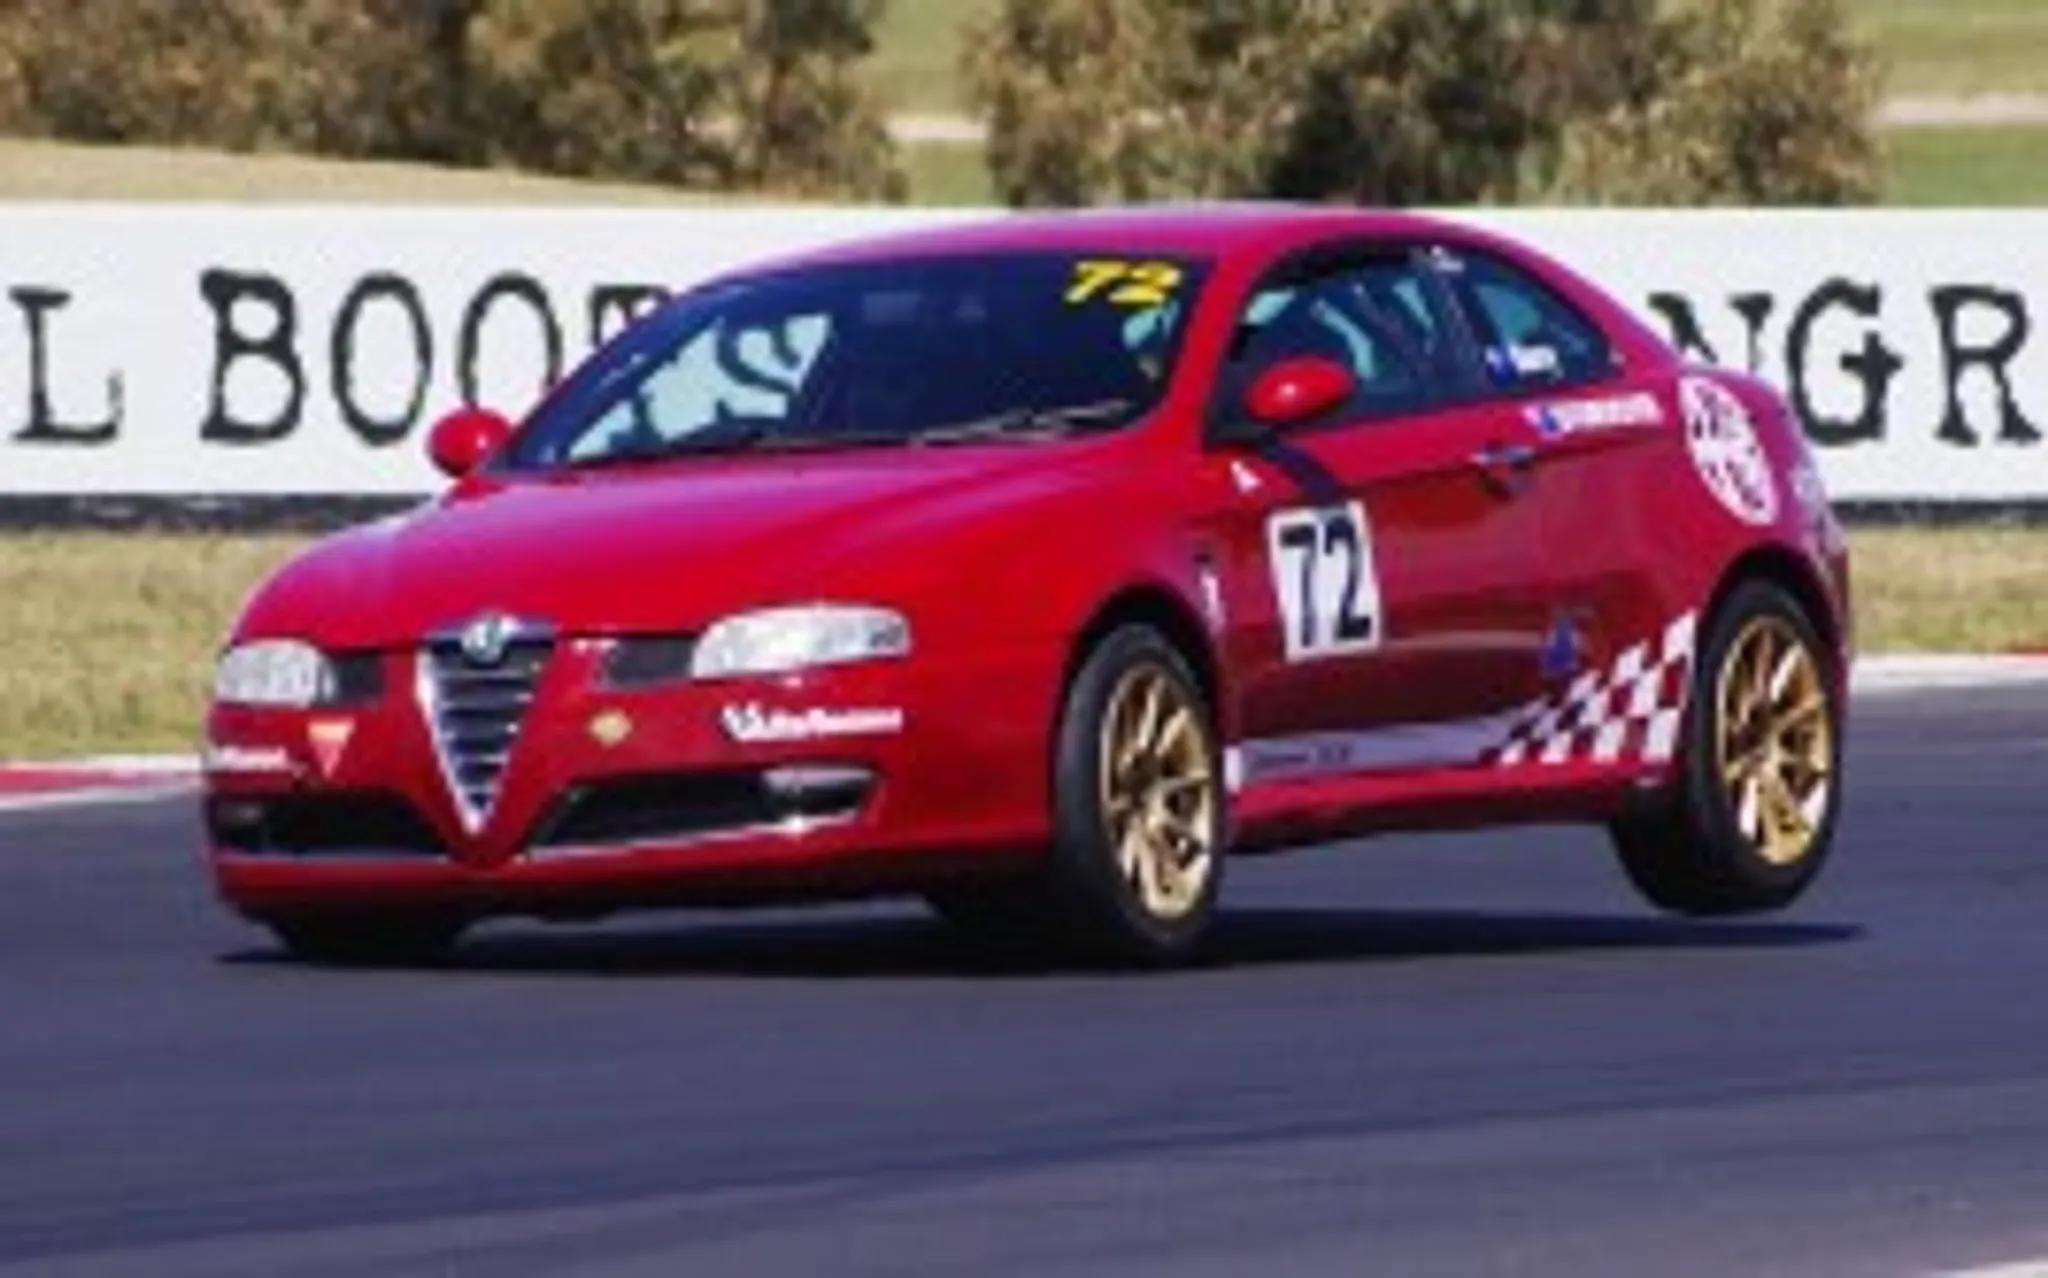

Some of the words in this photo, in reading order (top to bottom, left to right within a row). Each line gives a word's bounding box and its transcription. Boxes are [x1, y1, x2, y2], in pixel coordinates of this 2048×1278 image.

[1063, 260, 1183, 306] 72
[8, 286, 124, 441] L
[1280, 516, 1371, 647] 72
